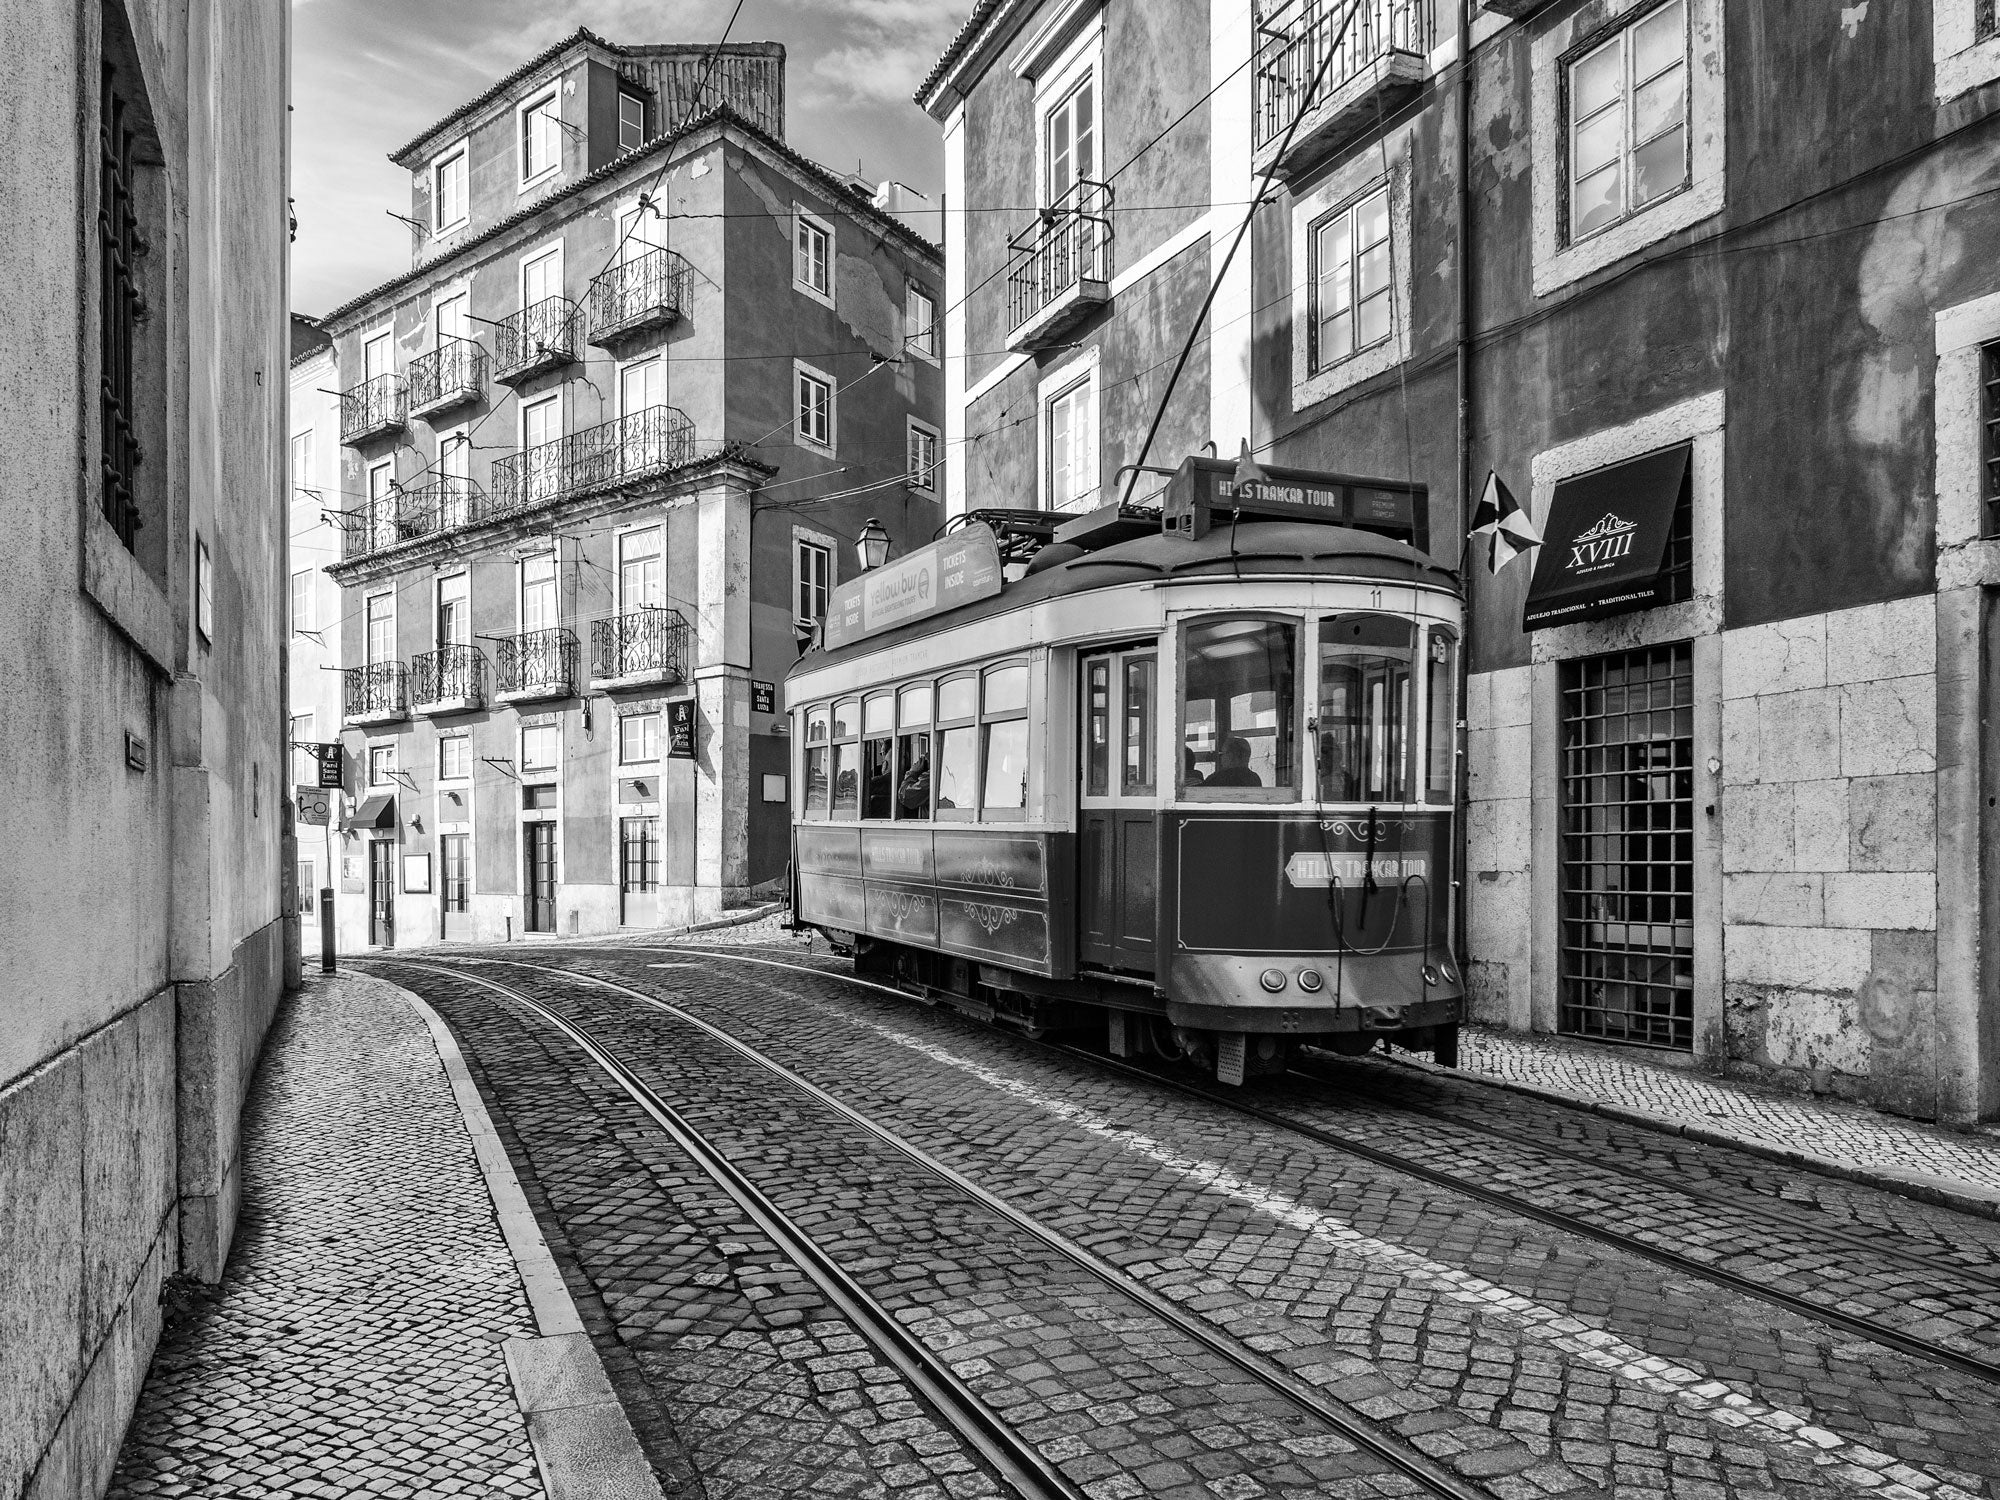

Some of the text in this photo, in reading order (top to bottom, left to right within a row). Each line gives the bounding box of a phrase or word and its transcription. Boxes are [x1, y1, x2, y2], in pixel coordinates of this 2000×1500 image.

[1219, 480, 1335, 507] HILS TRAMCAR TOUR
[1565, 532, 1636, 569] XVIII
[942, 550, 966, 571] TICKETS
[870, 572, 918, 606] yellow bus
[944, 570, 964, 590] INSIDE
[844, 594, 861, 612] TICKETS
[1370, 589, 1382, 608] 11
[1526, 590, 1655, 621] AZULEJO TRADICIONAL TRADITIONAL TILES
[845, 612, 859, 627] INSIDE
[753, 681, 773, 691] TRAVESSA
[756, 695, 769, 704] SANTA
[1297, 859, 1342, 878] HILLS
[1401, 859, 1427, 877] TOUR
